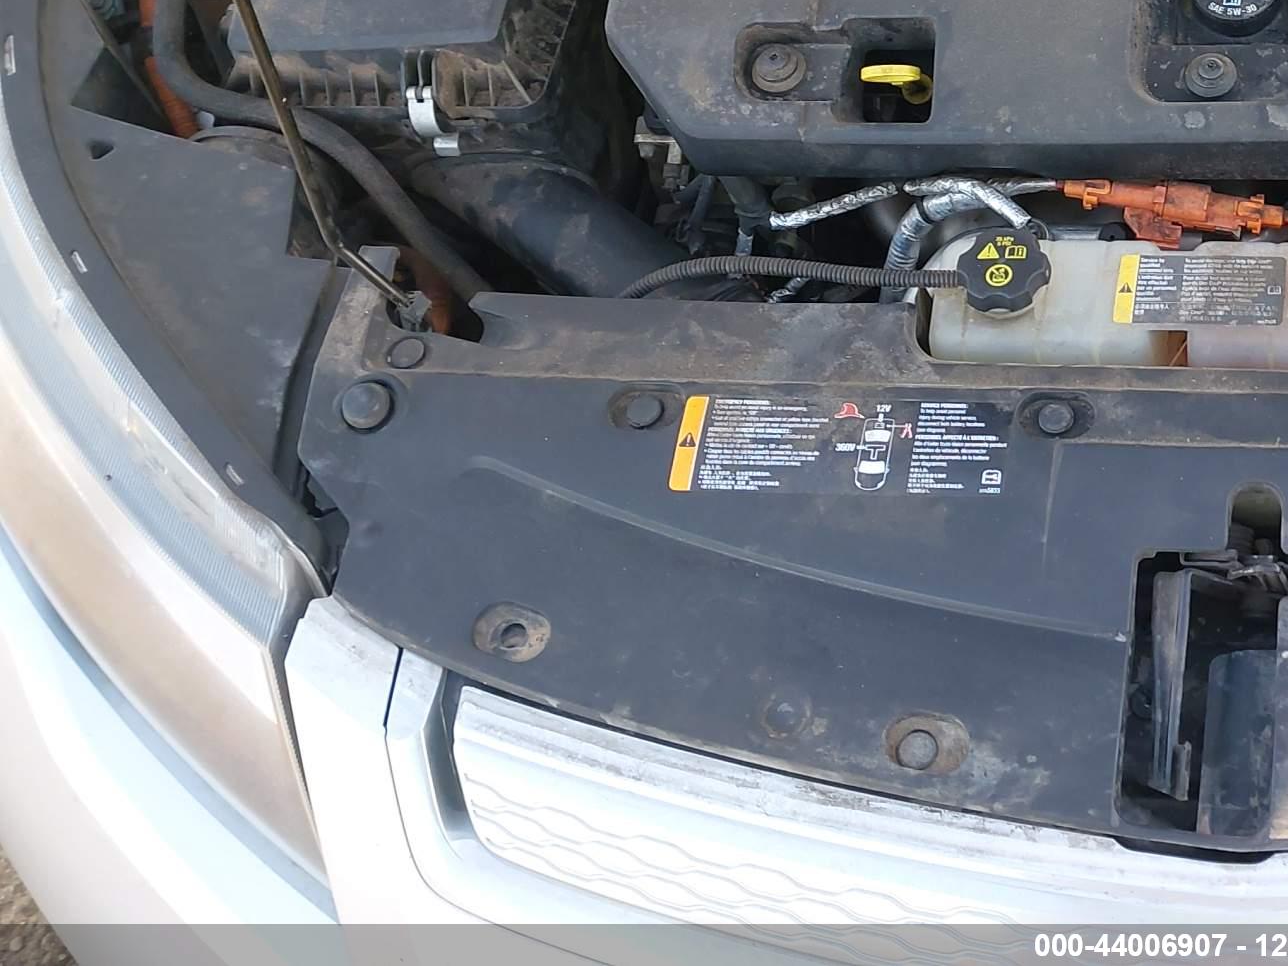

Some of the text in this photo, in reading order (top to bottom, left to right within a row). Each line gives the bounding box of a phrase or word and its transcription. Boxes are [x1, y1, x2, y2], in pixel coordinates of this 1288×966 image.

[1208, 1, 1257, 16] SAE 5W-30
[876, 404, 892, 413] 12V
